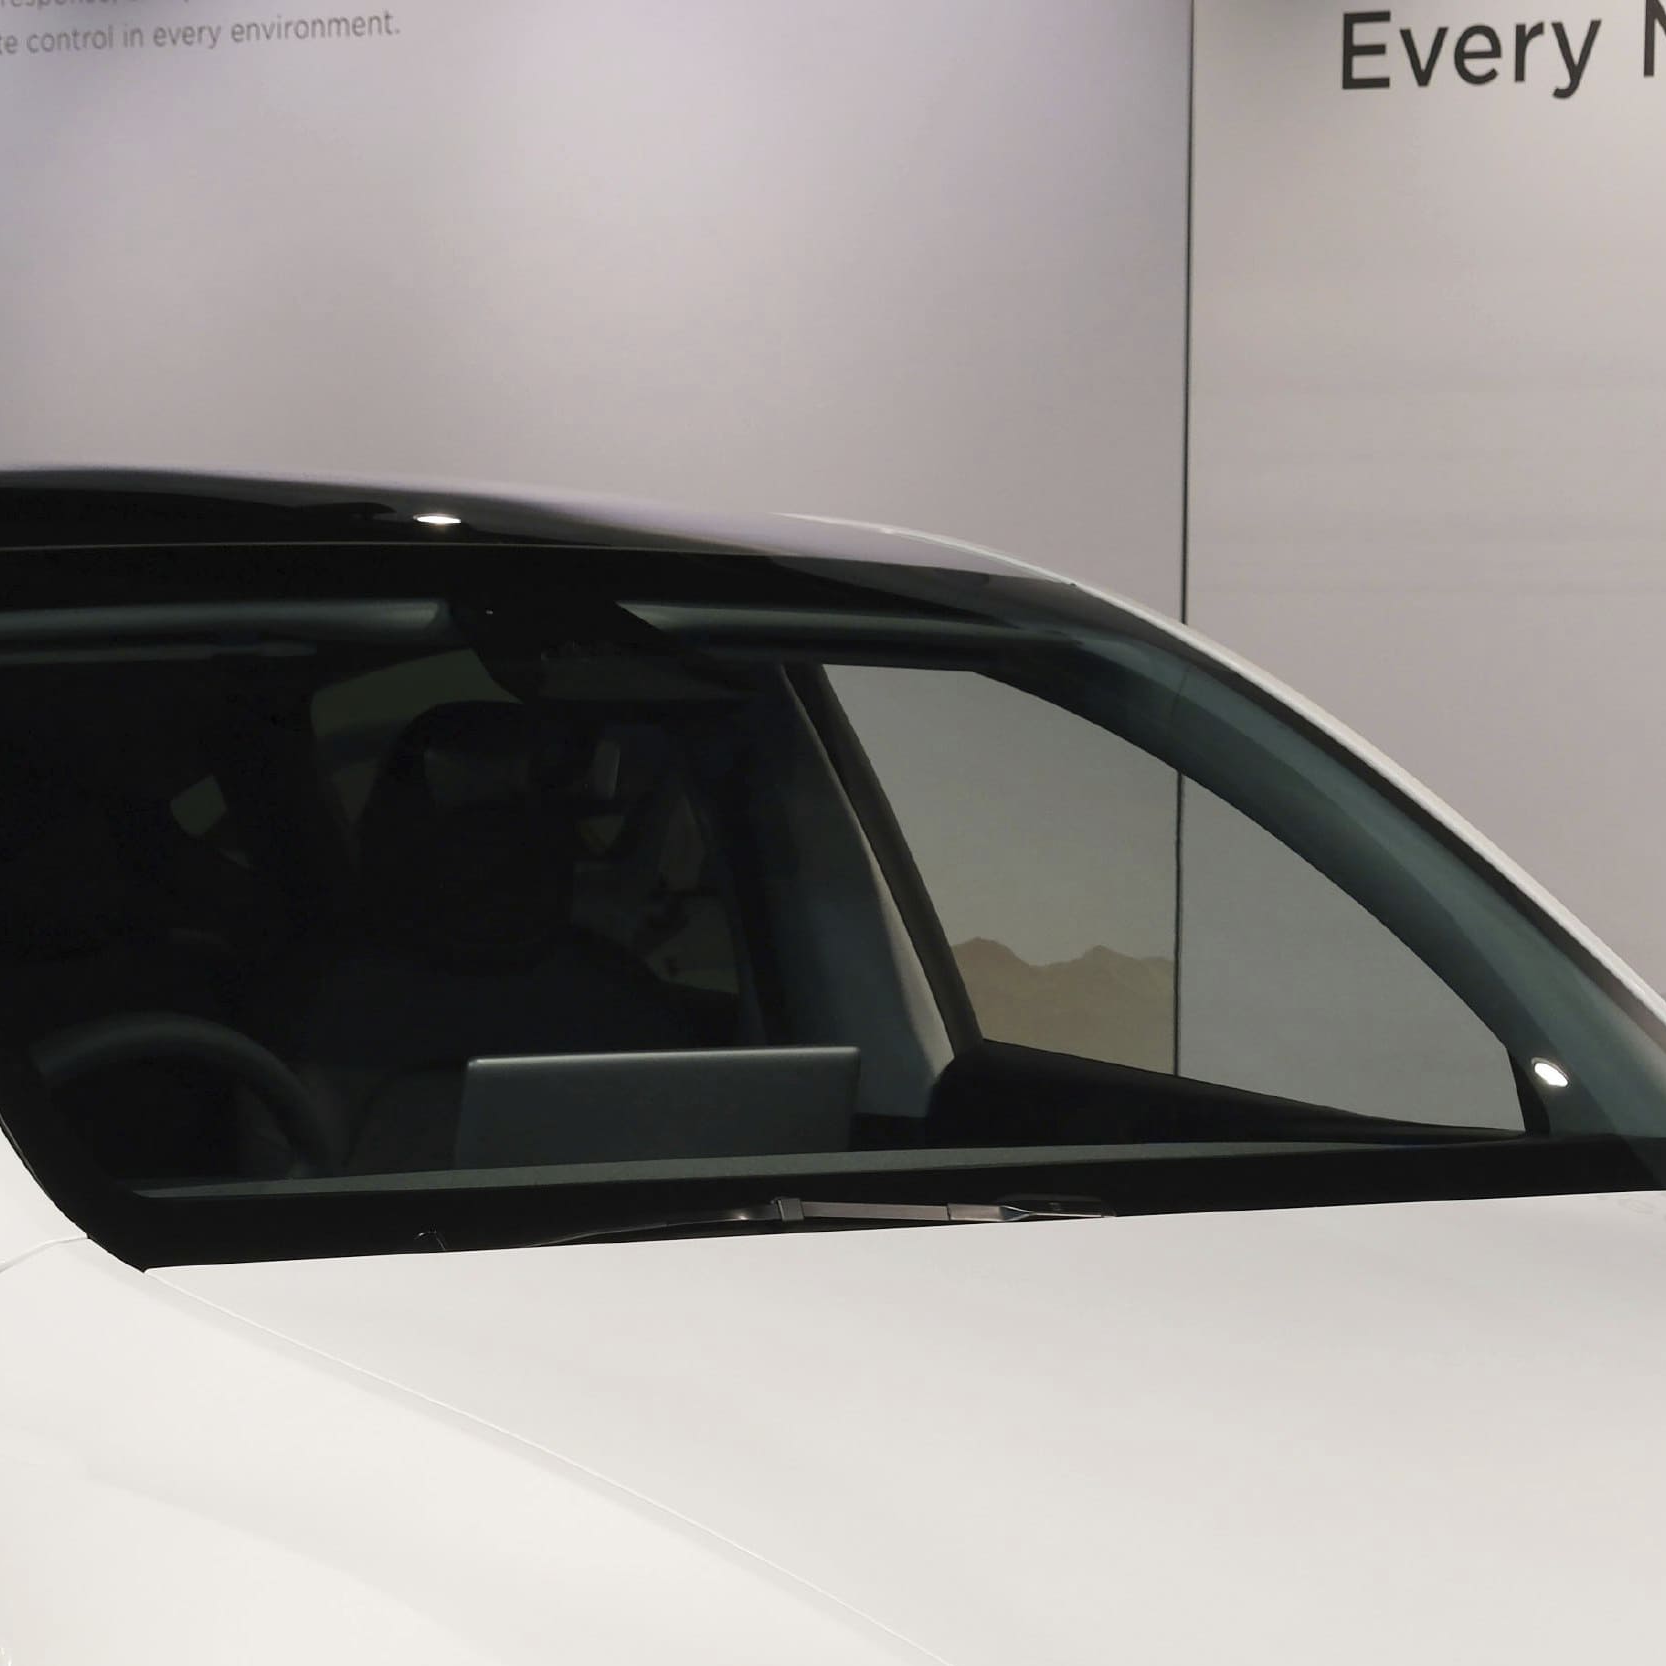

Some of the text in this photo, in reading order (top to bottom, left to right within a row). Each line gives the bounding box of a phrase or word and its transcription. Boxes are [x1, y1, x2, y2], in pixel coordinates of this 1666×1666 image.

[25, 24, 114, 54] control
[122, 22, 144, 49] in
[152, 24, 222, 50] every
[229, 10, 402, 44] environment.
[1340, 9, 1603, 101] Every
